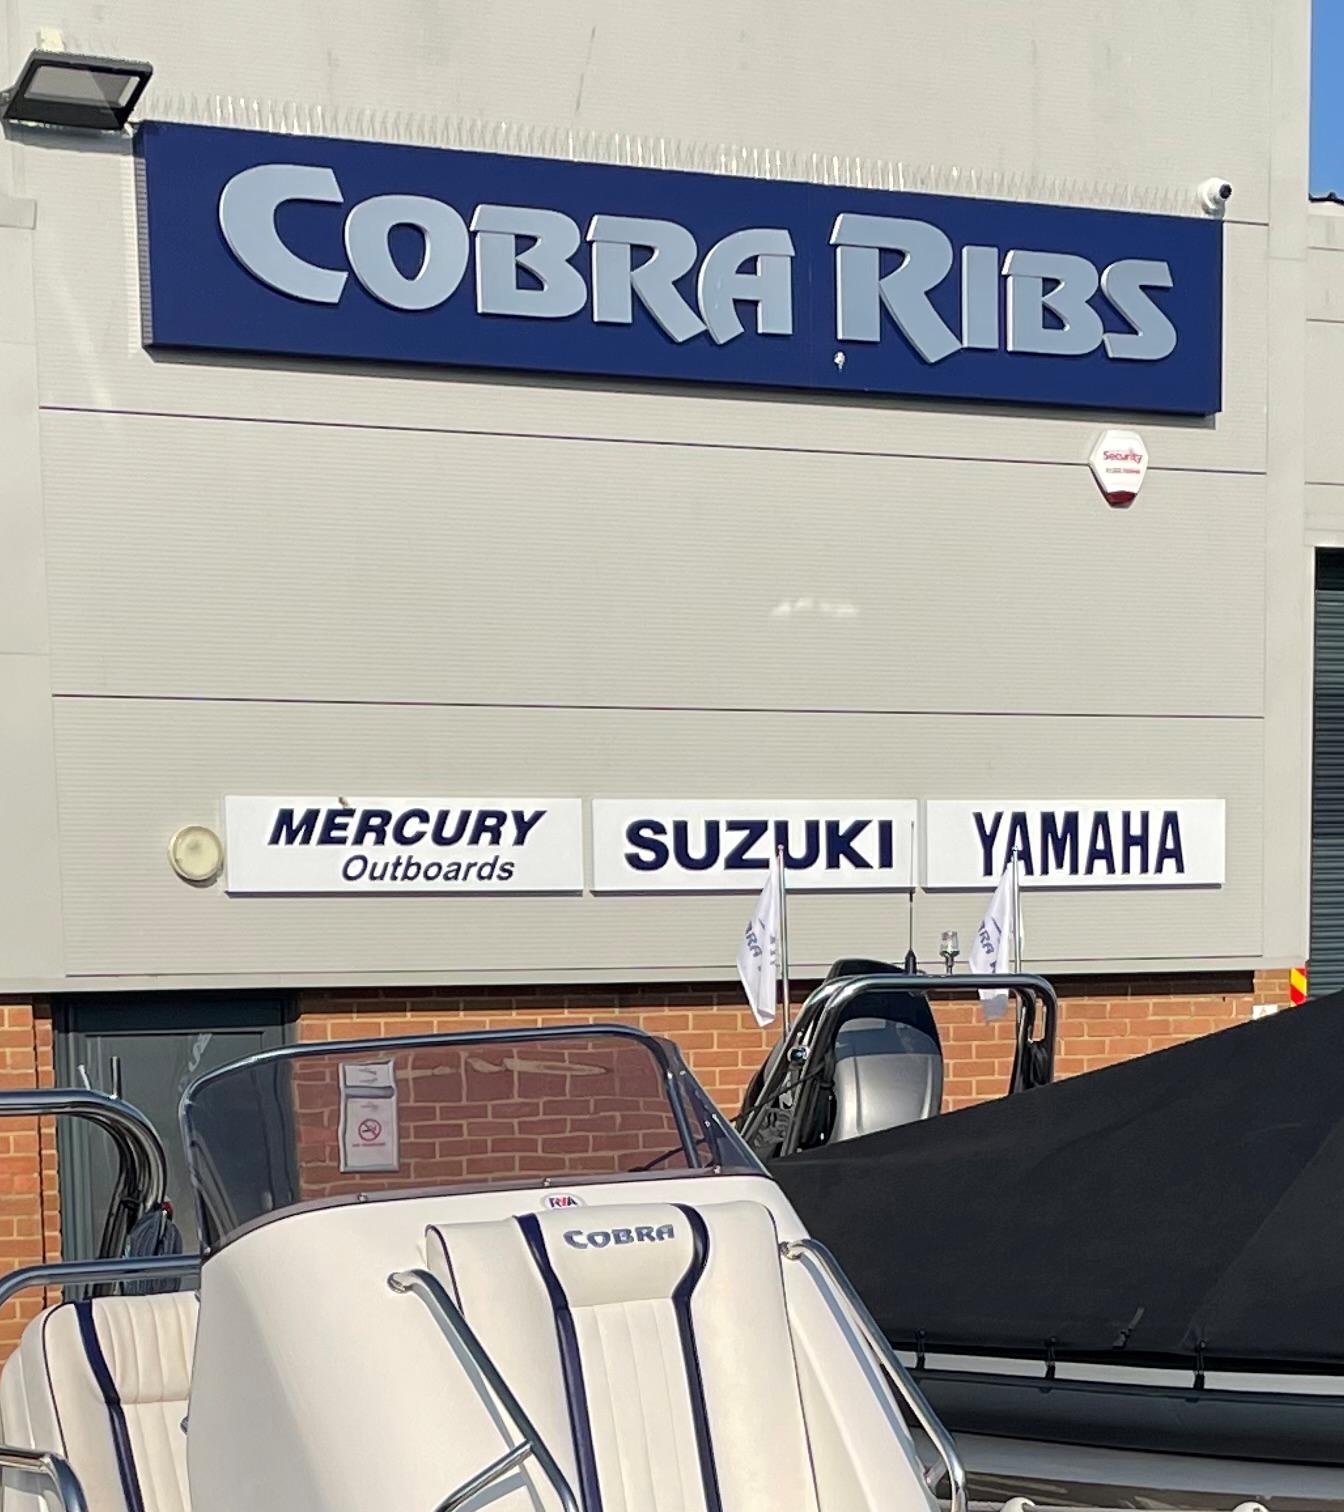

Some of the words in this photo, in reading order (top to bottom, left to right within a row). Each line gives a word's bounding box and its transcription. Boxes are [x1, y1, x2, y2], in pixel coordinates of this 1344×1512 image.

[219, 163, 795, 345] COBRA
[830, 213, 1178, 363] RIBS
[268, 808, 548, 847] MERCURY
[624, 818, 894, 872] SUZUKI
[972, 810, 1185, 877] YAMAHA
[341, 854, 515, 882] Outboards
[563, 1224, 675, 1250] COBRA
